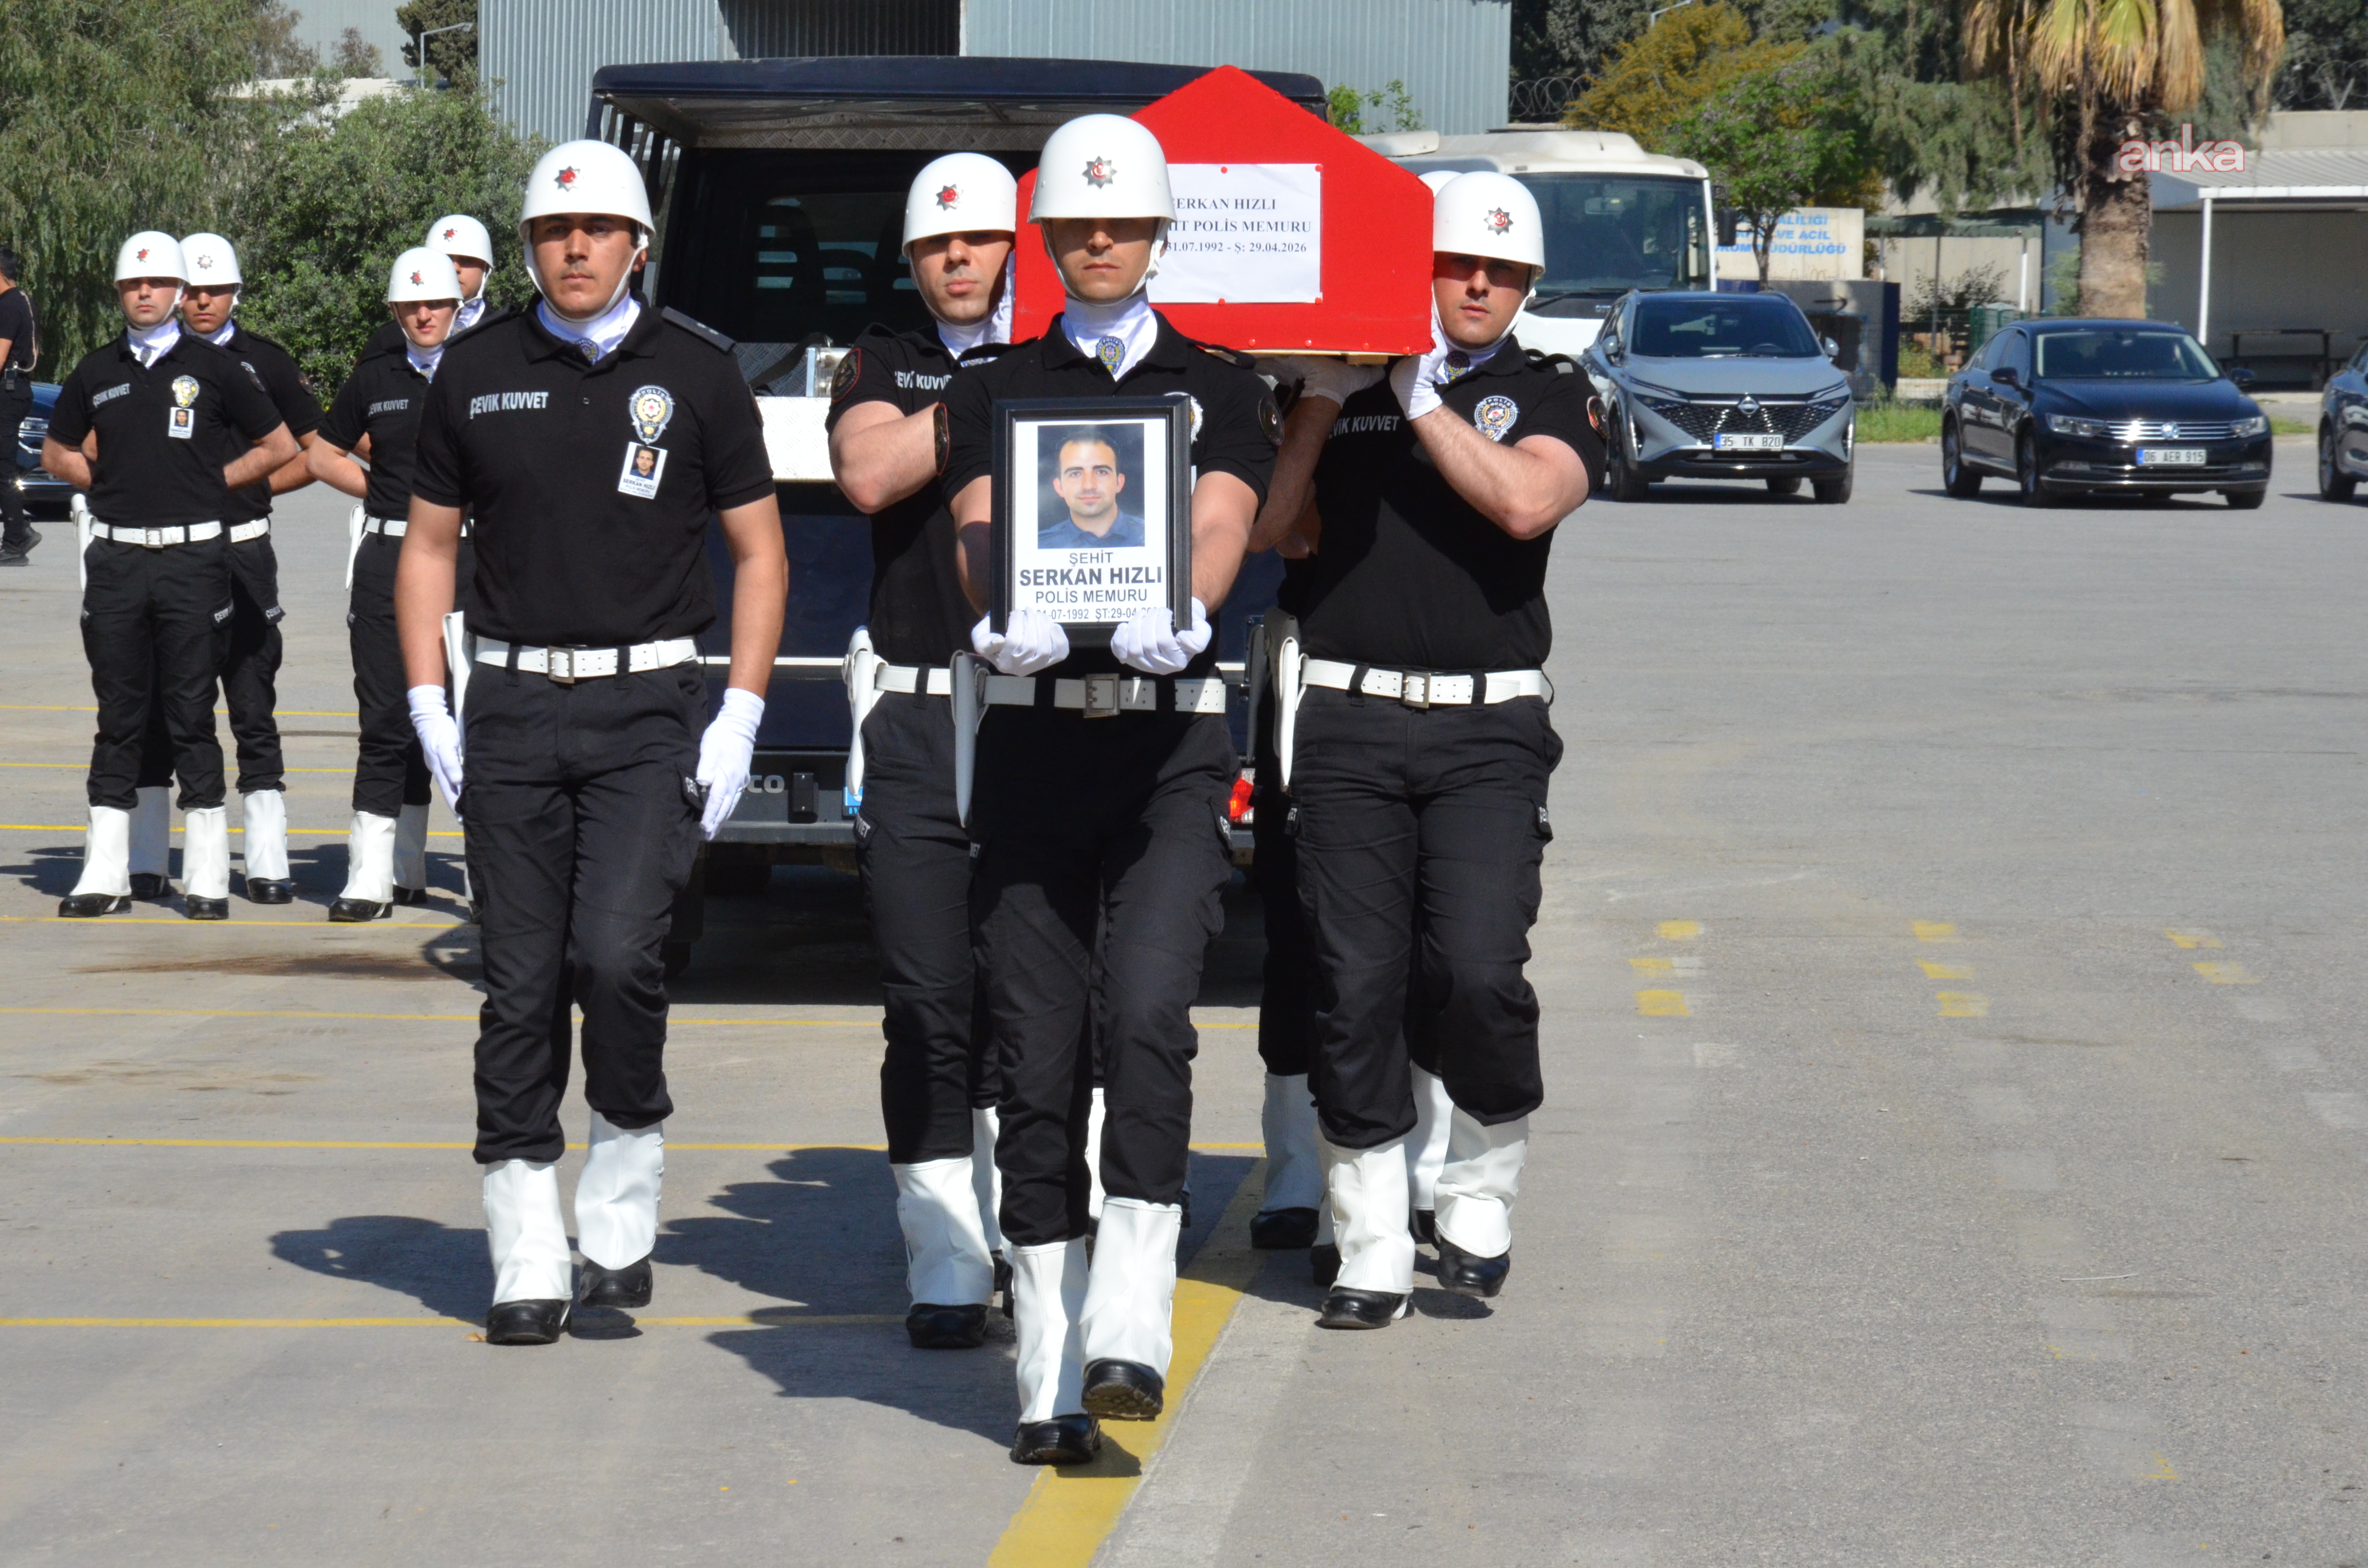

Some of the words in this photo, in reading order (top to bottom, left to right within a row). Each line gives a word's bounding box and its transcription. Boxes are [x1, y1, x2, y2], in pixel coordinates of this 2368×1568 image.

[1172, 198, 1229, 209] ERKAN
[1234, 198, 1276, 209] HIZLI
[1194, 219, 1237, 232] POLİS
[1242, 220, 1311, 232] MEMURU
[1776, 230, 1794, 239] VE
[1799, 228, 1830, 240] ACİL
[1249, 242, 1307, 252] 29.04.2026
[383, 399, 409, 412] KUVVET
[469, 393, 500, 419] ÇEVİK
[501, 392, 549, 410] KUVVET
[1351, 415, 1400, 432] KUVVET
[1721, 436, 1733, 446] 35
[1742, 436, 1754, 447] TK
[1762, 436, 1781, 447] 820
[2144, 451, 2156, 462] 06
[2185, 451, 2204, 462] 915
[1069, 550, 1113, 567] ŞEHİT
[1019, 568, 1102, 586] SERKAN
[1110, 566, 1162, 585] HIZLI
[1036, 588, 1078, 603] POLİS
[1083, 588, 1147, 603] MEMURU
